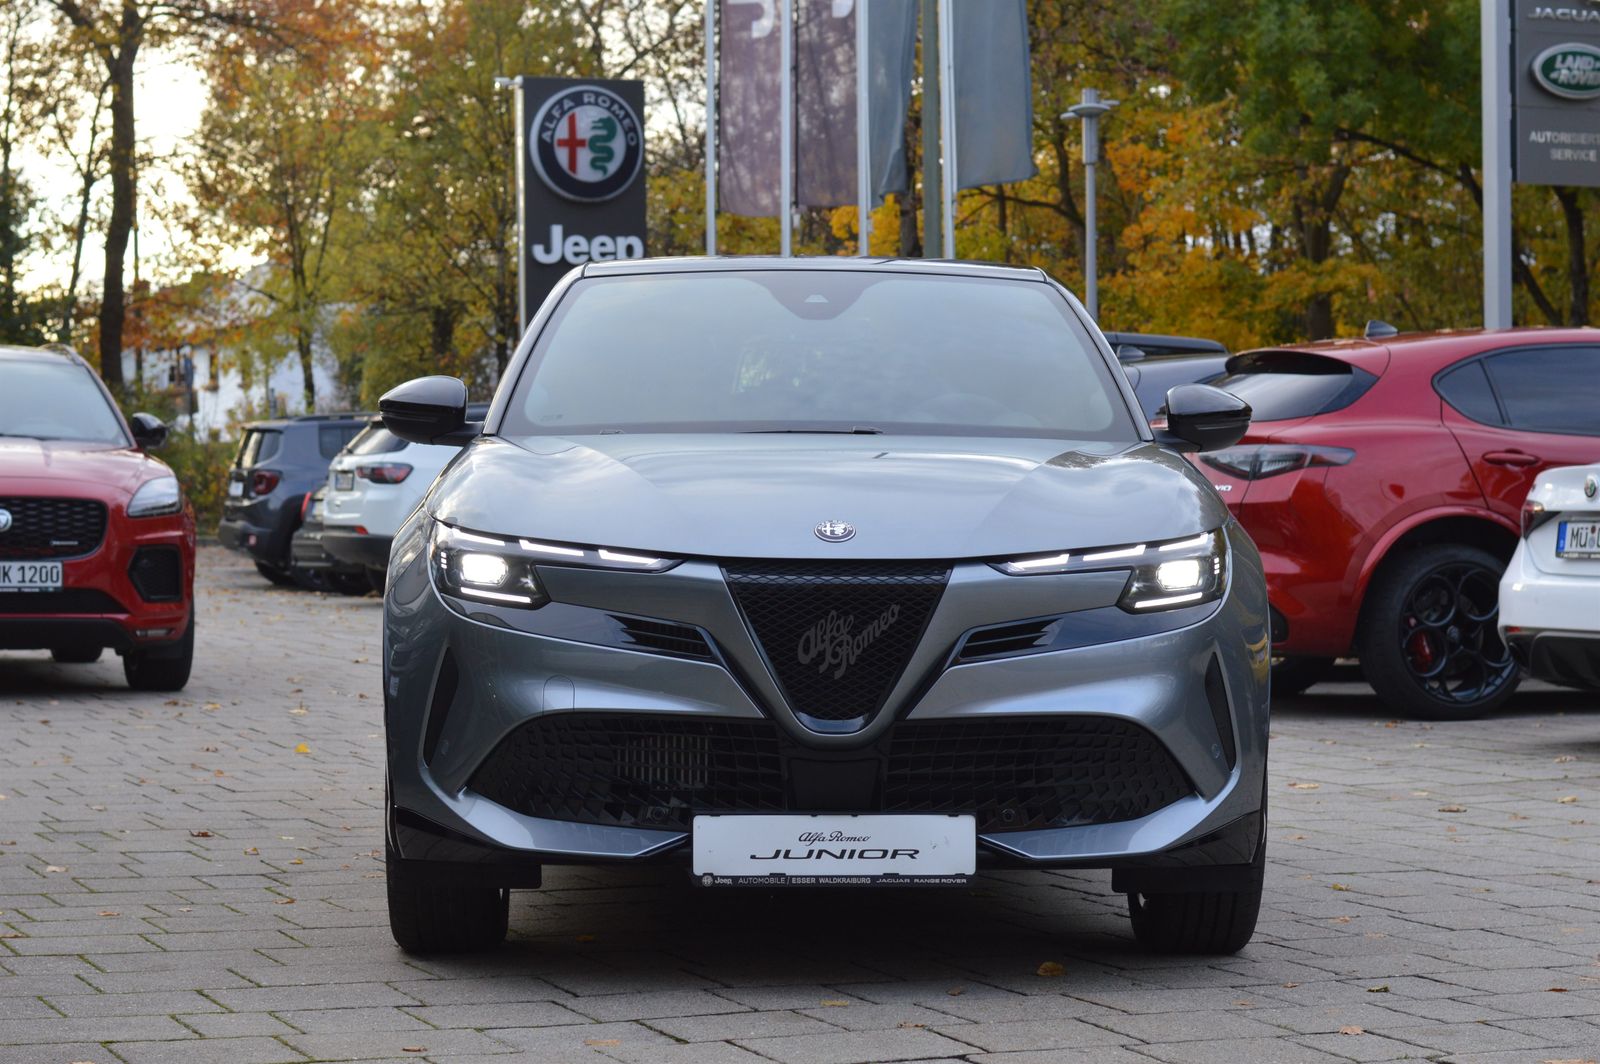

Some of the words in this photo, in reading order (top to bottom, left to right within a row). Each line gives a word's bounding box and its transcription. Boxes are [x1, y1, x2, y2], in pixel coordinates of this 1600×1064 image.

[1555, 54, 1594, 70] LAND
[541, 98, 575, 143] ALFA
[583, 92, 638, 146] ROMEO
[532, 224, 644, 265] Jeep
[0, 565, 12, 584] K
[17, 565, 60, 584] 1200
[829, 604, 900, 680] Romeo
[798, 832, 827, 846] Alfa
[828, 831, 871, 842] Romeo
[749, 849, 920, 860] JUNIOR
[714, 877, 733, 885] Jeep
[738, 877, 785, 885] AUTOMOBILE
